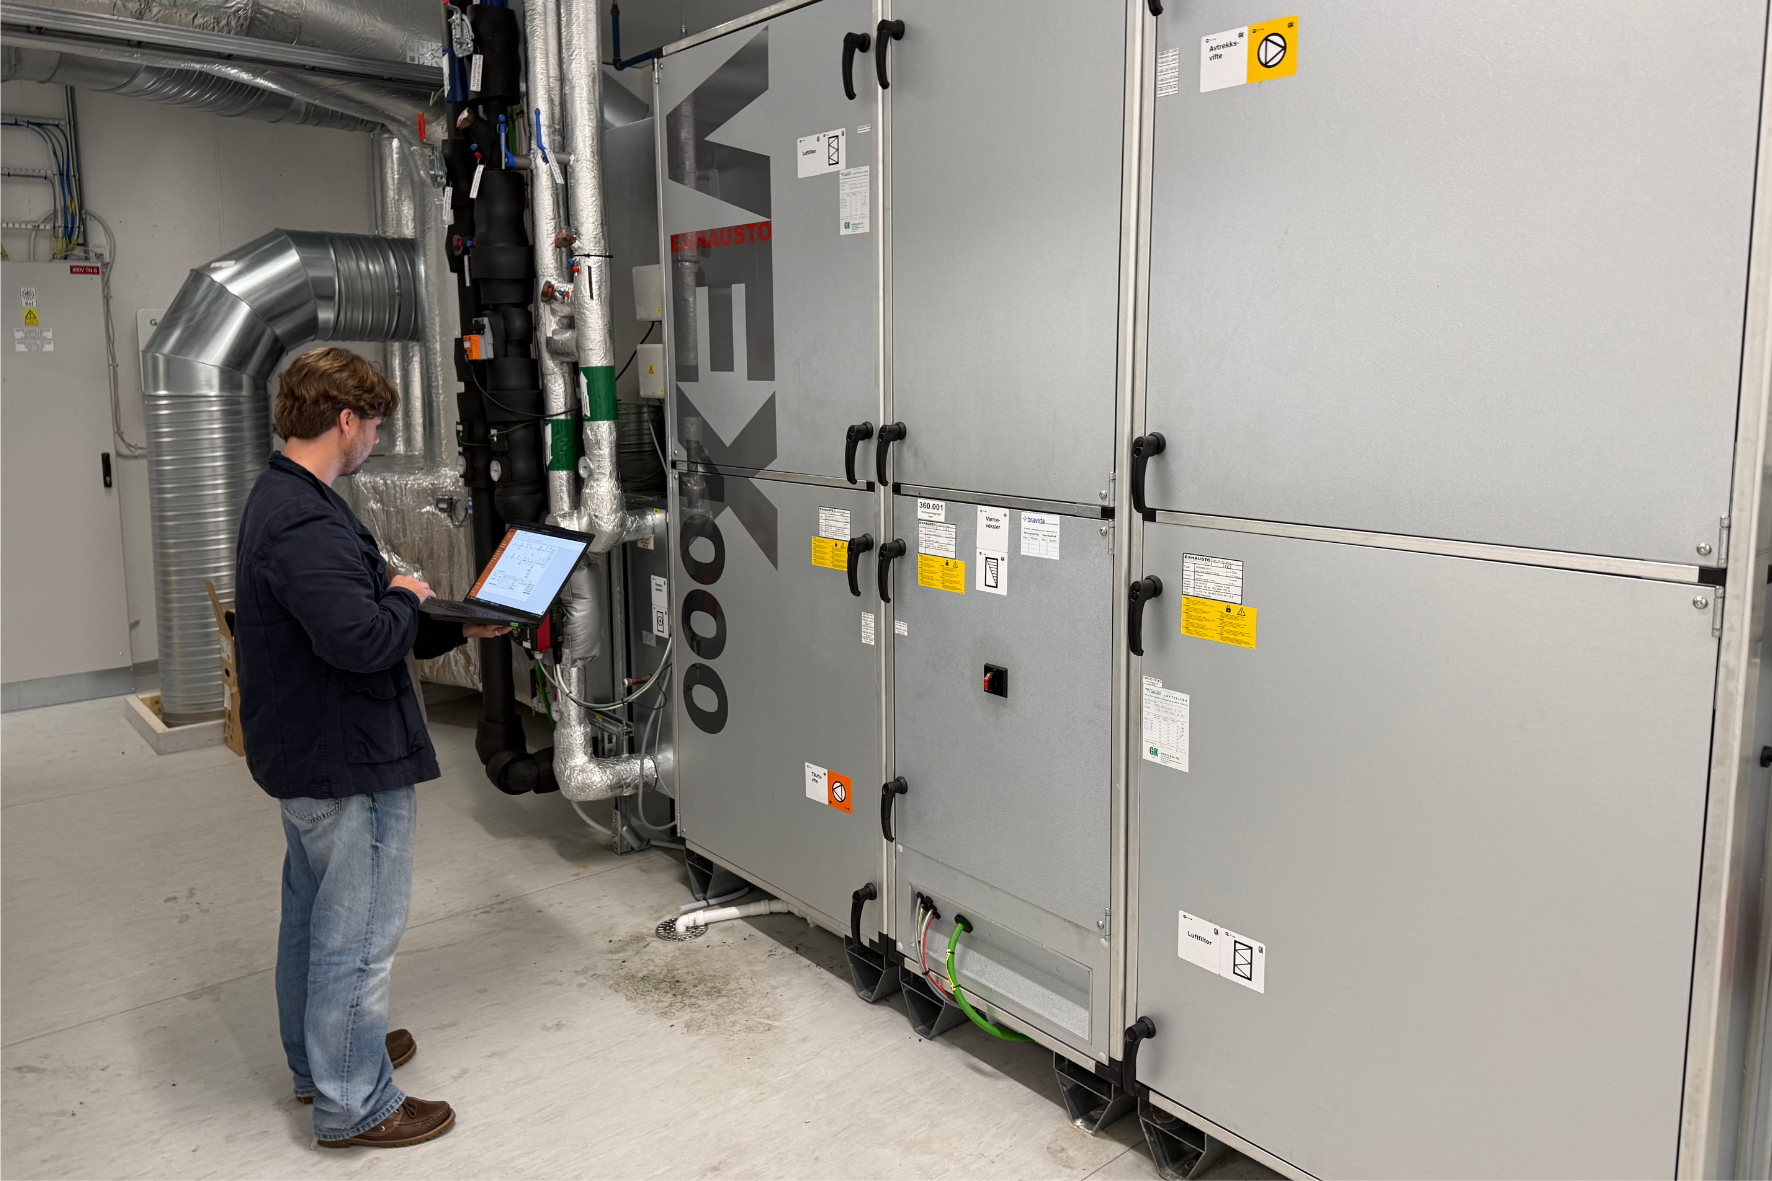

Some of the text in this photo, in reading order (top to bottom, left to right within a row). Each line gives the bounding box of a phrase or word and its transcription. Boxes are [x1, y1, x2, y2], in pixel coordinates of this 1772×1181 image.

[1209, 41, 1239, 52] Avtrekks-
[1209, 53, 1222, 61] vifte
[670, 220, 772, 253] EXHAUSTO
[919, 502, 944, 511] 360.001
[1187, 930, 1212, 945] Luftfilter
